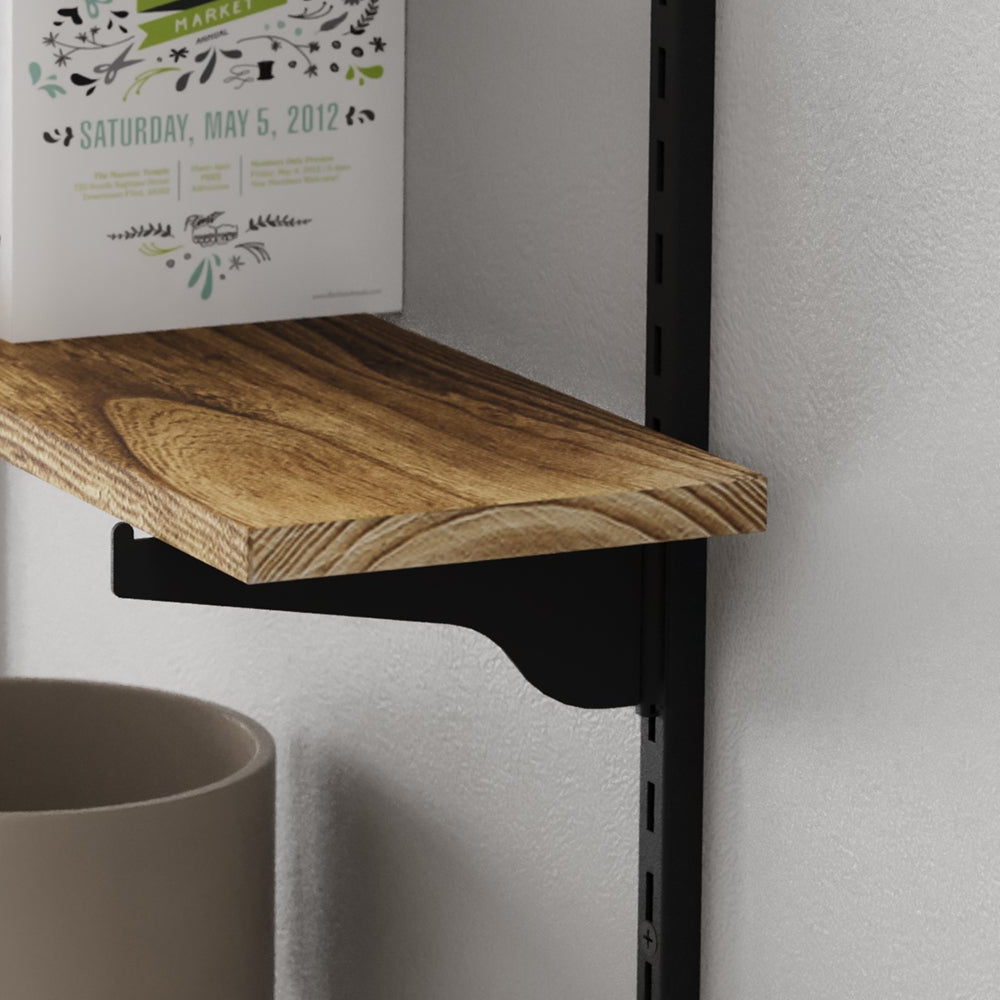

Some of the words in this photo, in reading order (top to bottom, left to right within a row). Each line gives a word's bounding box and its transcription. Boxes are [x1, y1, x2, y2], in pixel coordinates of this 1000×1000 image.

[80, 113, 196, 150] SATURDAY,
[204, 109, 249, 140] MAY
[257, 107, 278, 140] 5,
[287, 102, 339, 134] 2012
